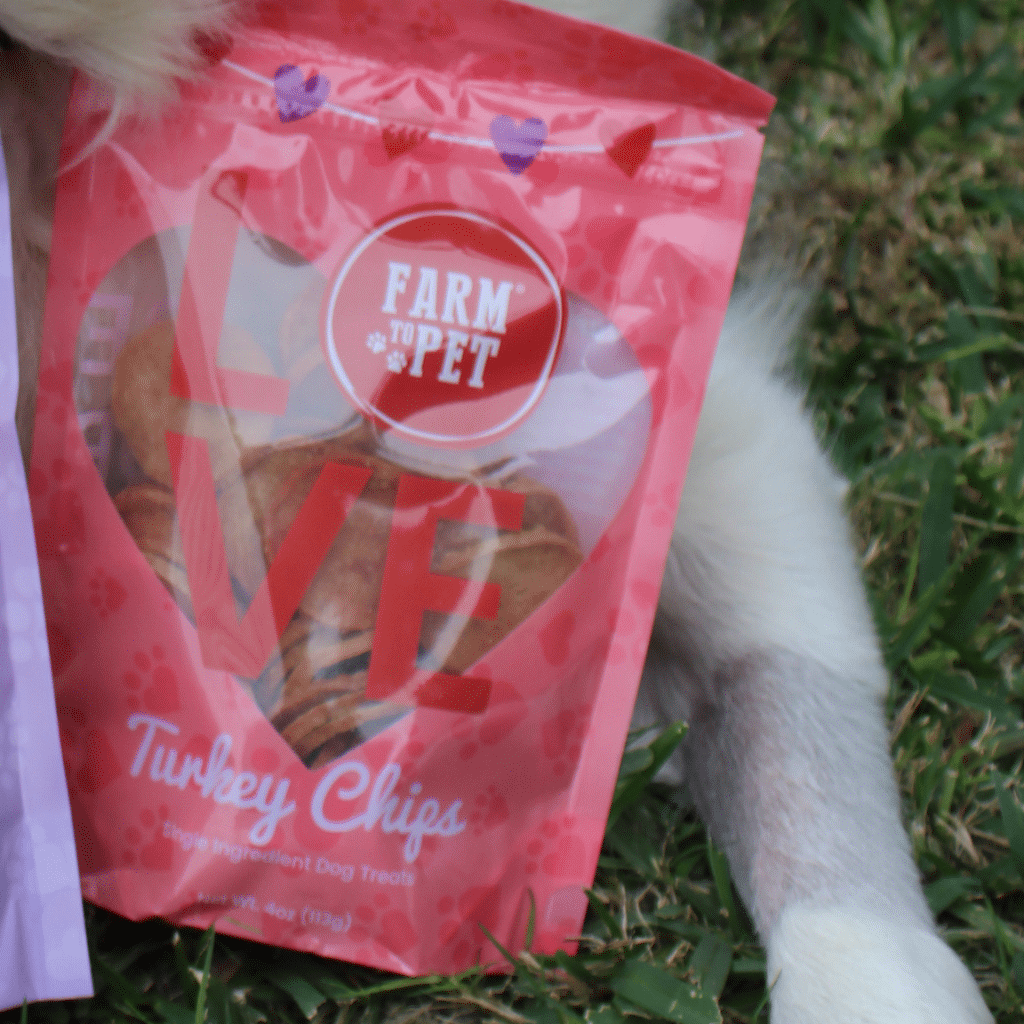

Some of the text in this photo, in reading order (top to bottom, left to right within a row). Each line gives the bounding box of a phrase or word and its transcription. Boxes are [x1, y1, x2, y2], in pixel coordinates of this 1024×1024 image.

[381, 260, 514, 334] FARM
[389, 319, 501, 388] TO PET
[127, 711, 466, 863] Turkey Chips
[316, 856, 354, 882] Dog
[361, 864, 415, 885] Treats
